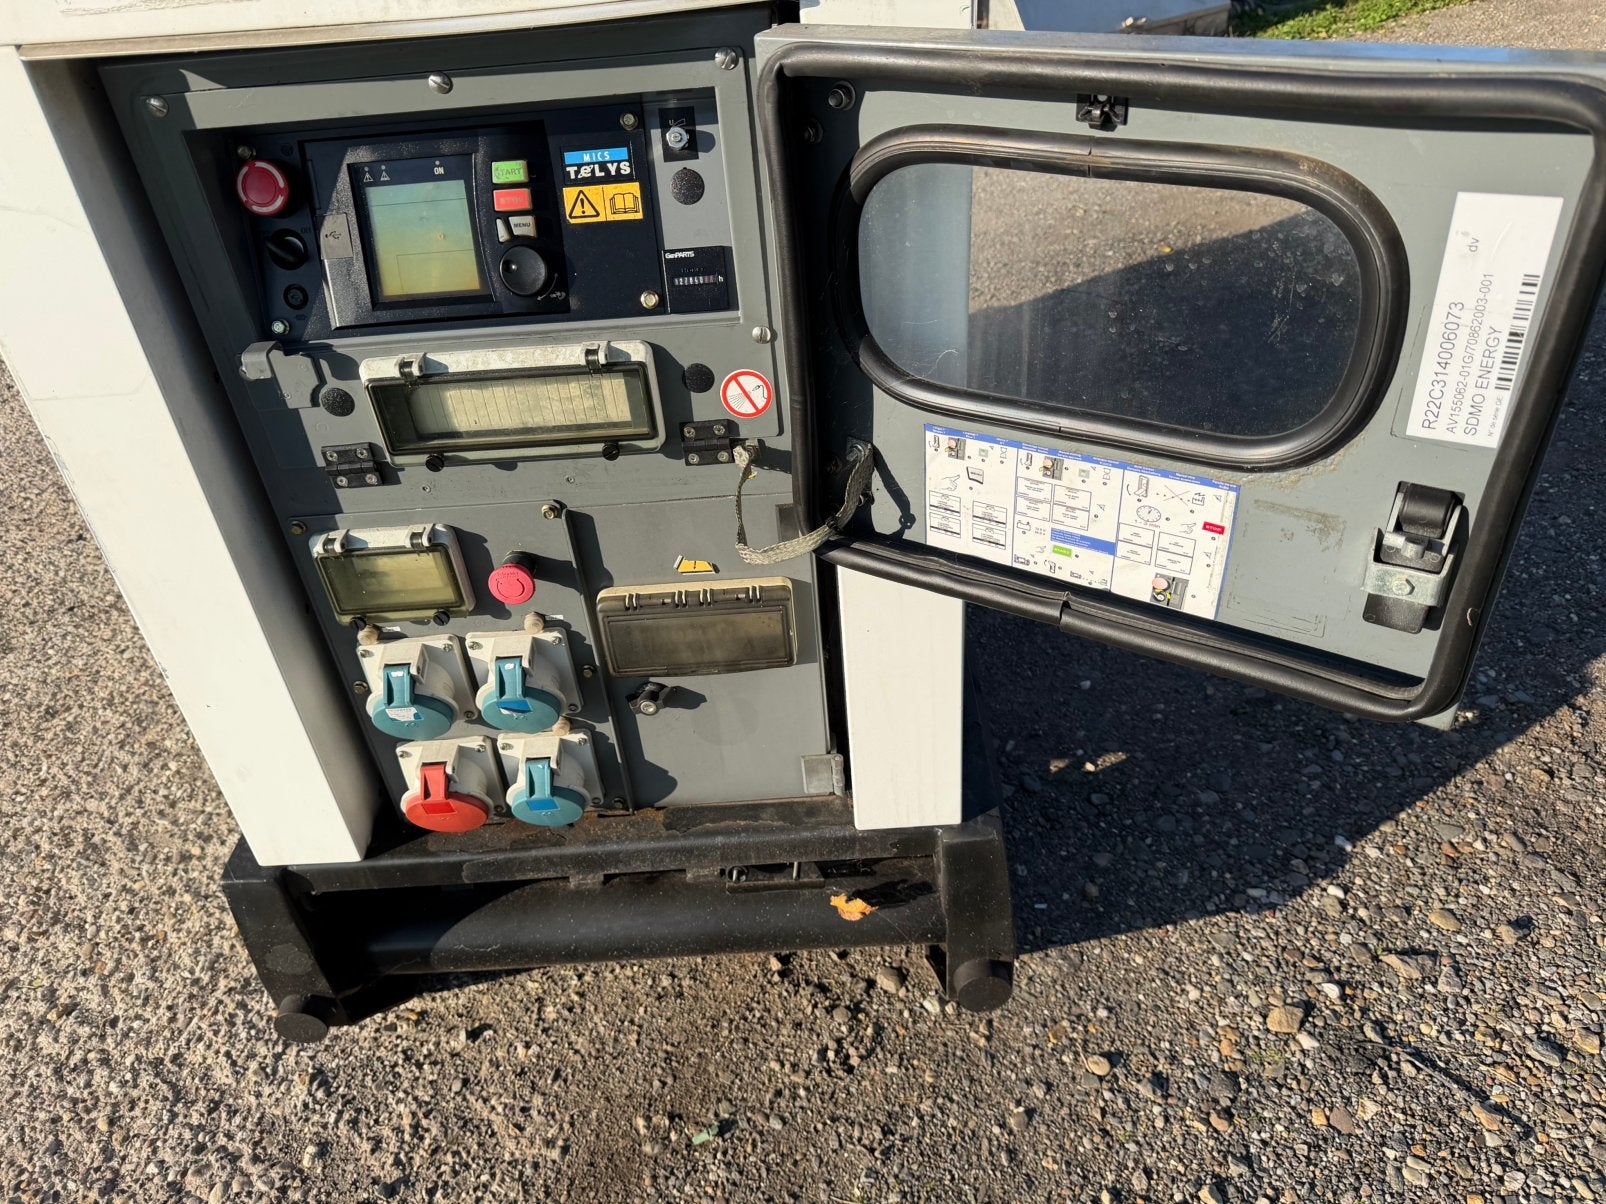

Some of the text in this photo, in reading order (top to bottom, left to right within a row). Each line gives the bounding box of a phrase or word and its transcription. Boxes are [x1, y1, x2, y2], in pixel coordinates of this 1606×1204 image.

[583, 151, 610, 162] MICS
[433, 166, 445, 176] ON
[513, 221, 531, 229] MENU
[665, 250, 695, 259] GenPARTS
[1421, 301, 1465, 431] R22C314006073
[1463, 325, 1503, 436] SDMO ENERGY
